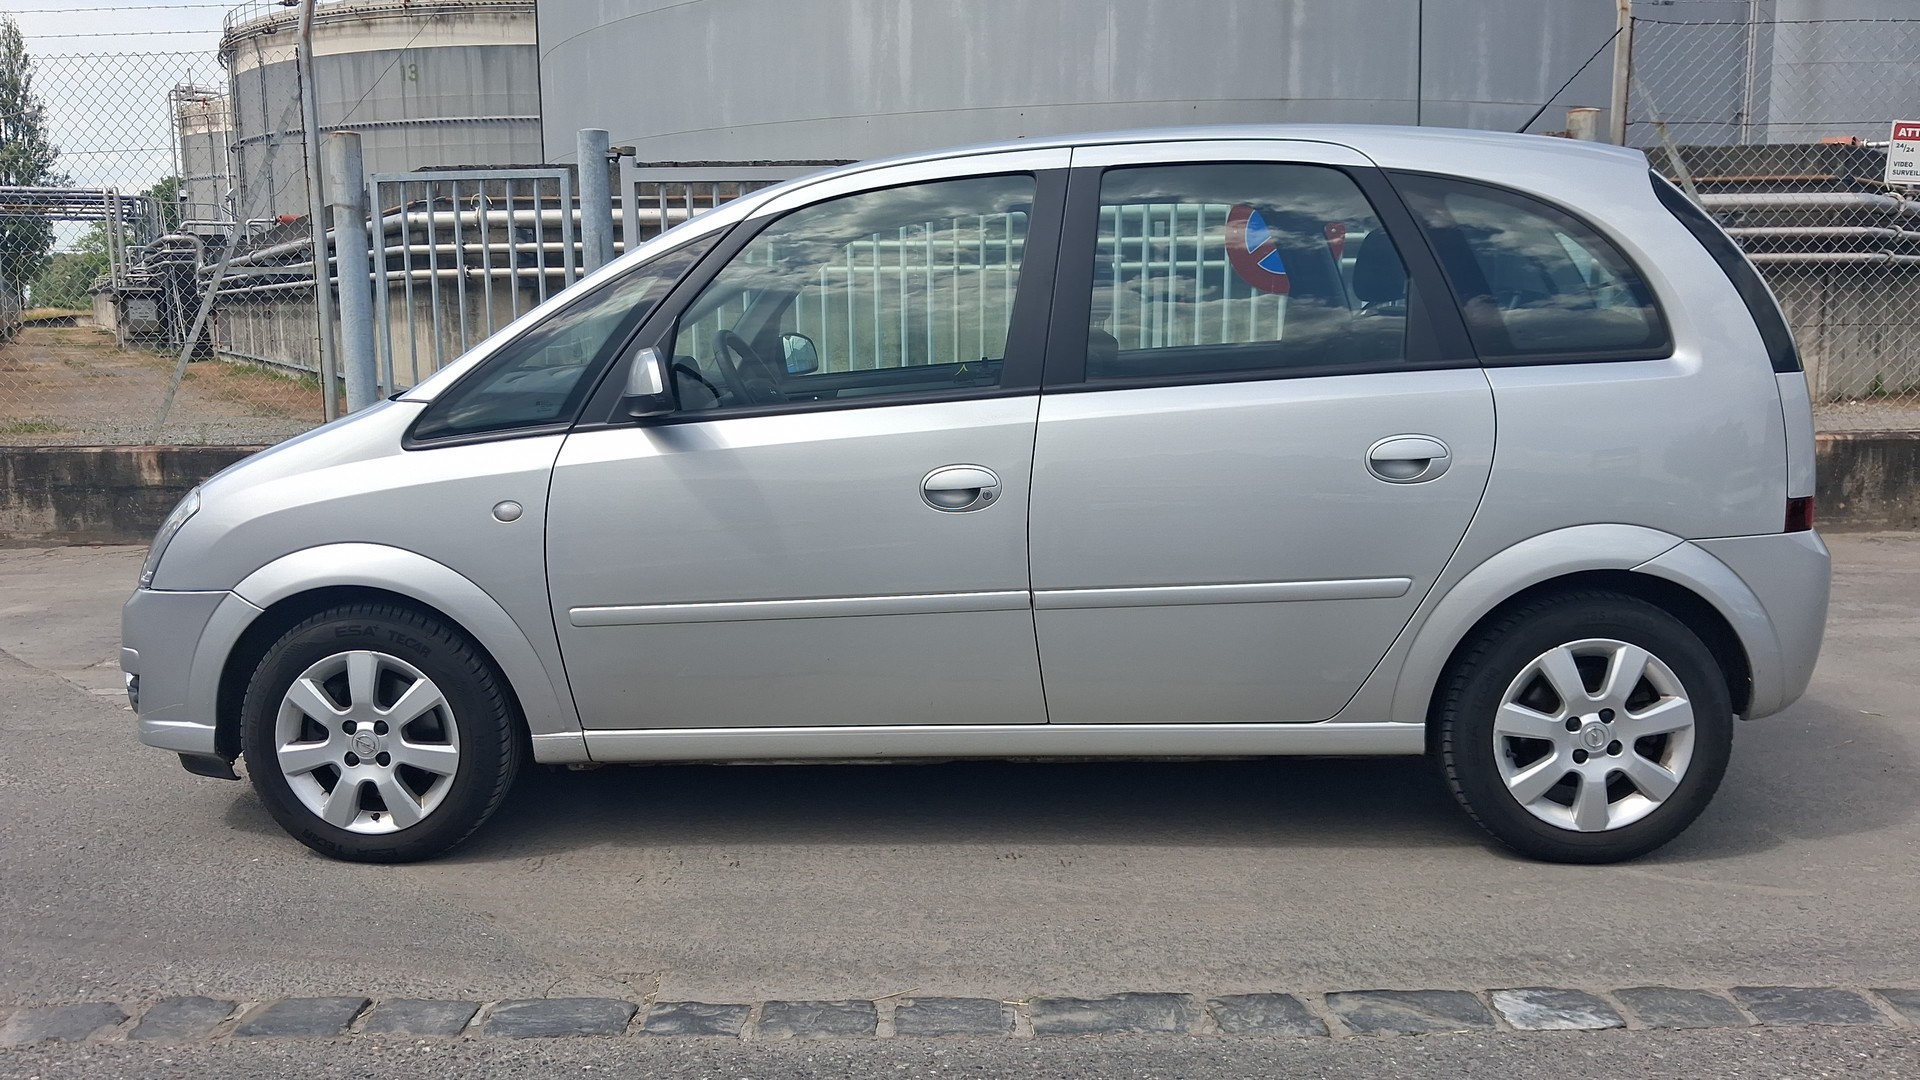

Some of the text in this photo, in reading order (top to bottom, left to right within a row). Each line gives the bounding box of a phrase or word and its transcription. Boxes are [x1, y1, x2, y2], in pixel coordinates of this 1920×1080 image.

[401, 63, 418, 81] 13
[1896, 143, 1915, 153] 24/24
[388, 630, 432, 658] TECAR
